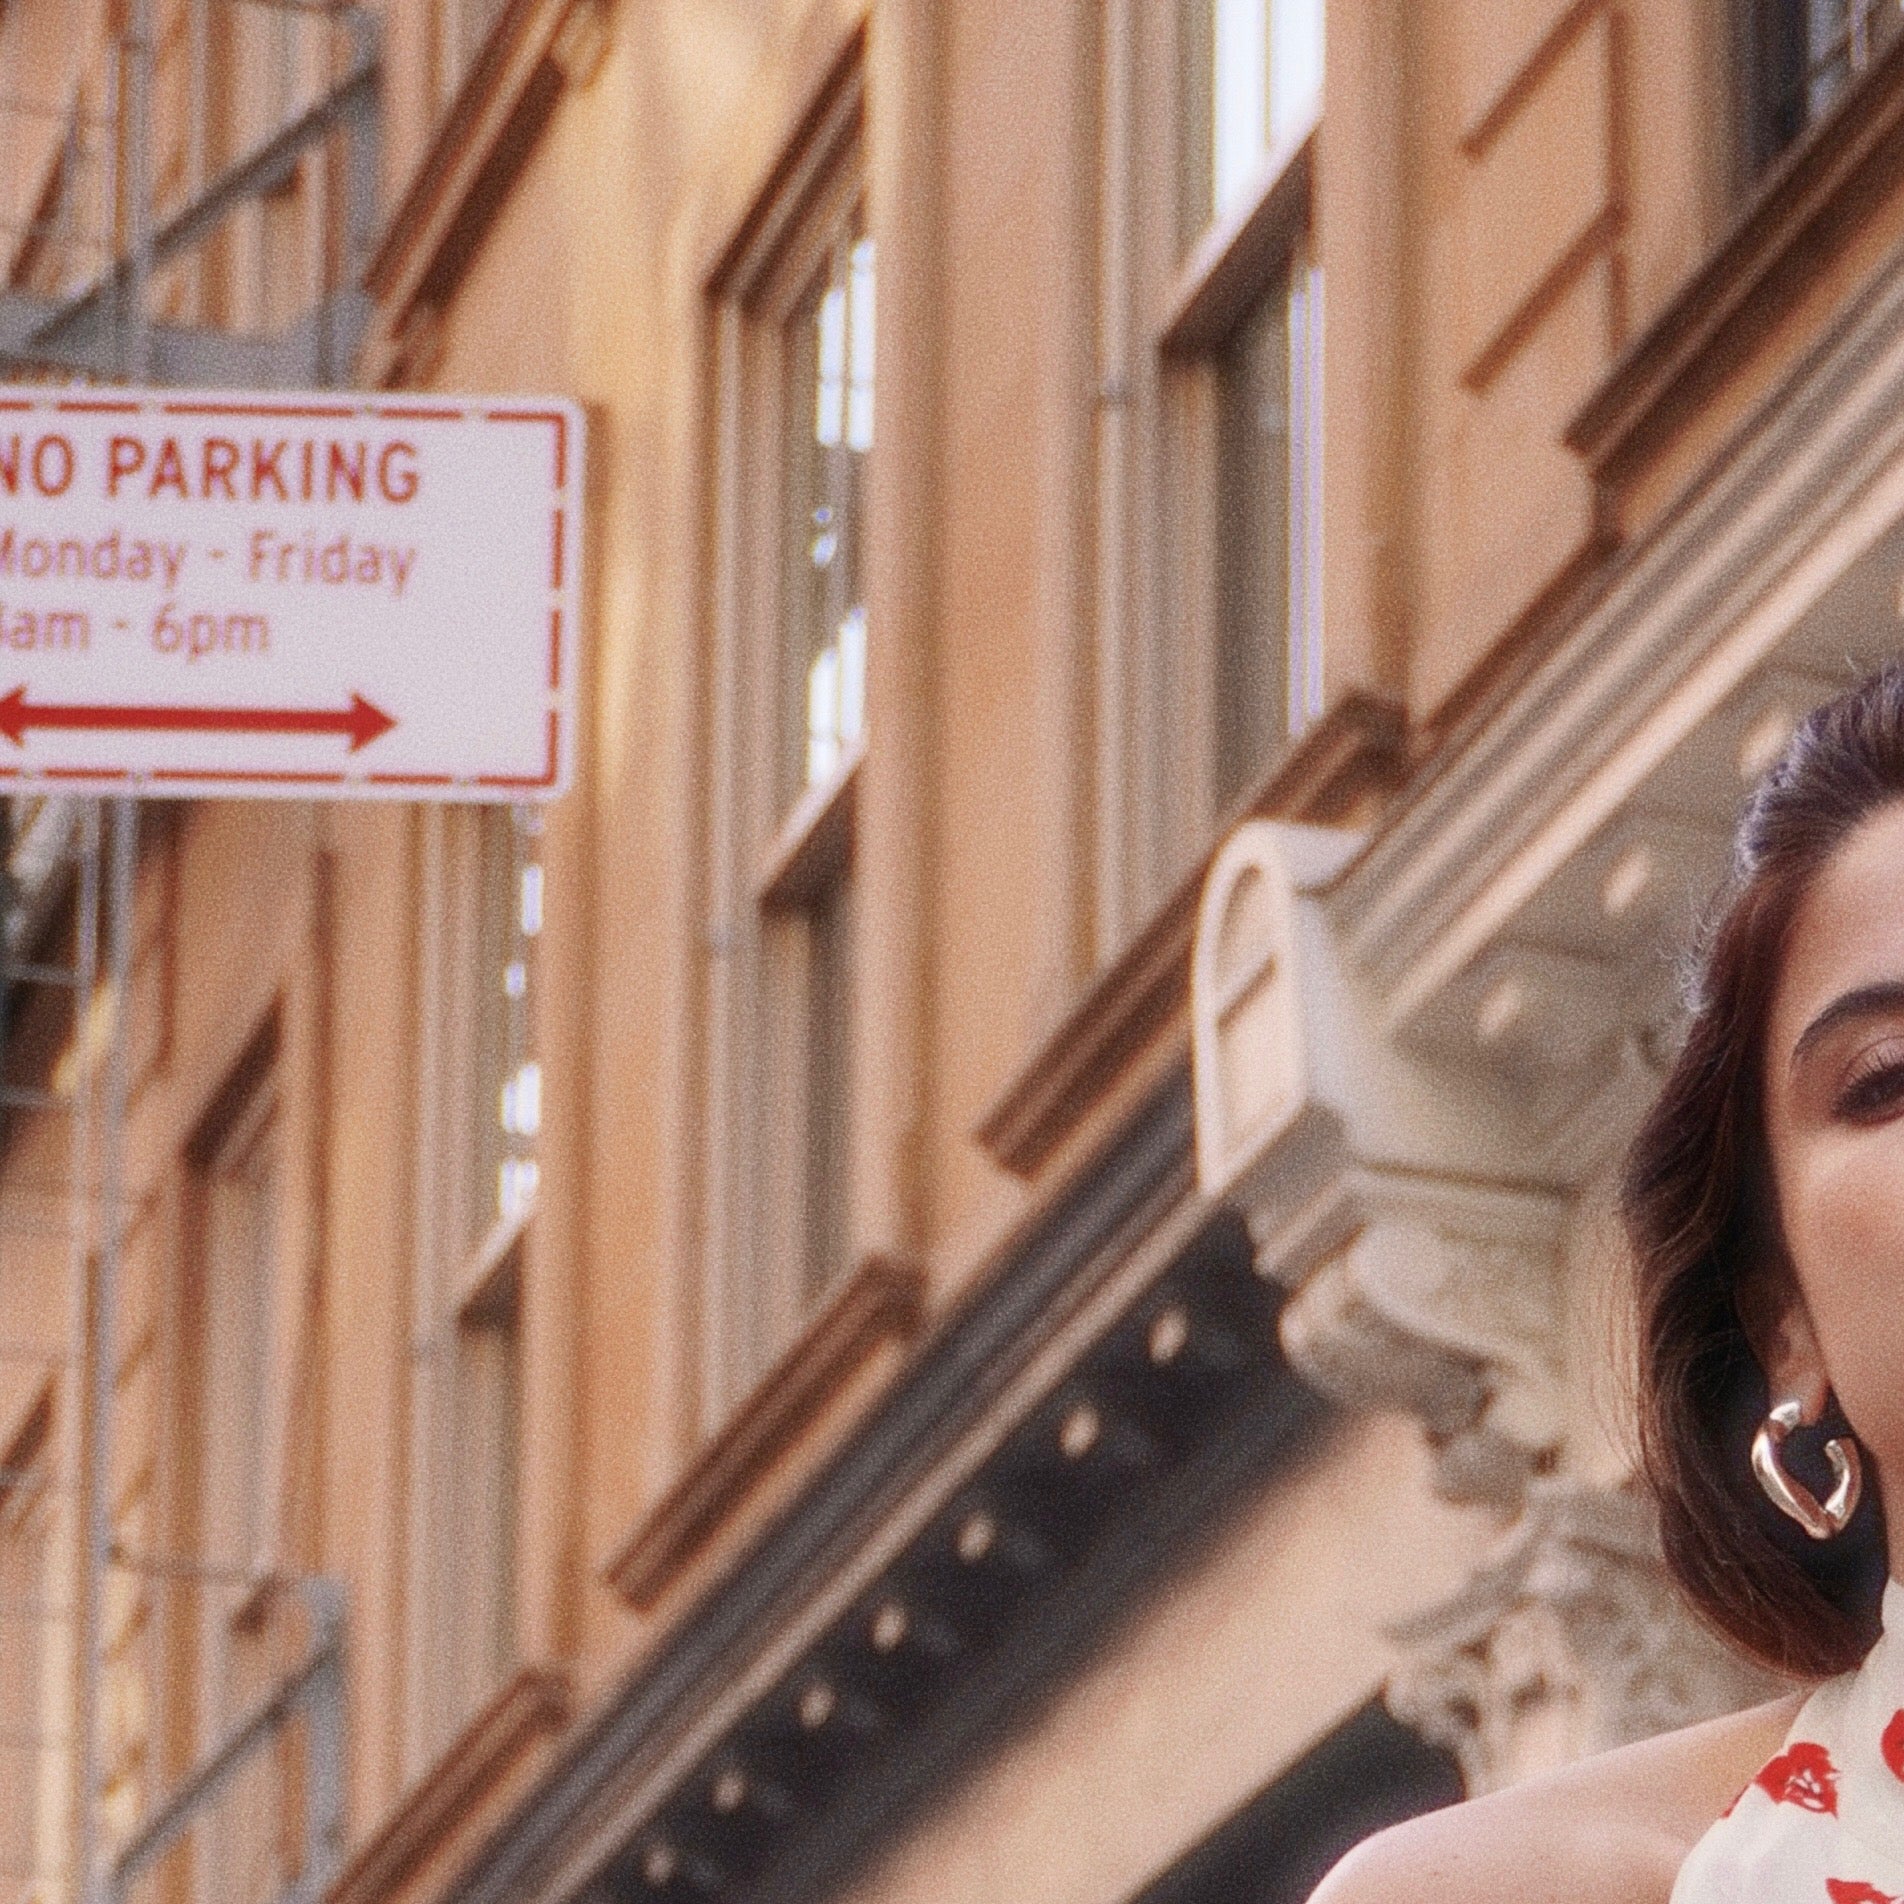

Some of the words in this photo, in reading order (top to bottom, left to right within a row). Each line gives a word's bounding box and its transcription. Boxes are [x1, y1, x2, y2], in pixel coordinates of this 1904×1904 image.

[105, 434, 420, 505] PARKING
[248, 528, 418, 598] Friday
[0, 606, 91, 654] am
[150, 601, 270, 664] 6pm
